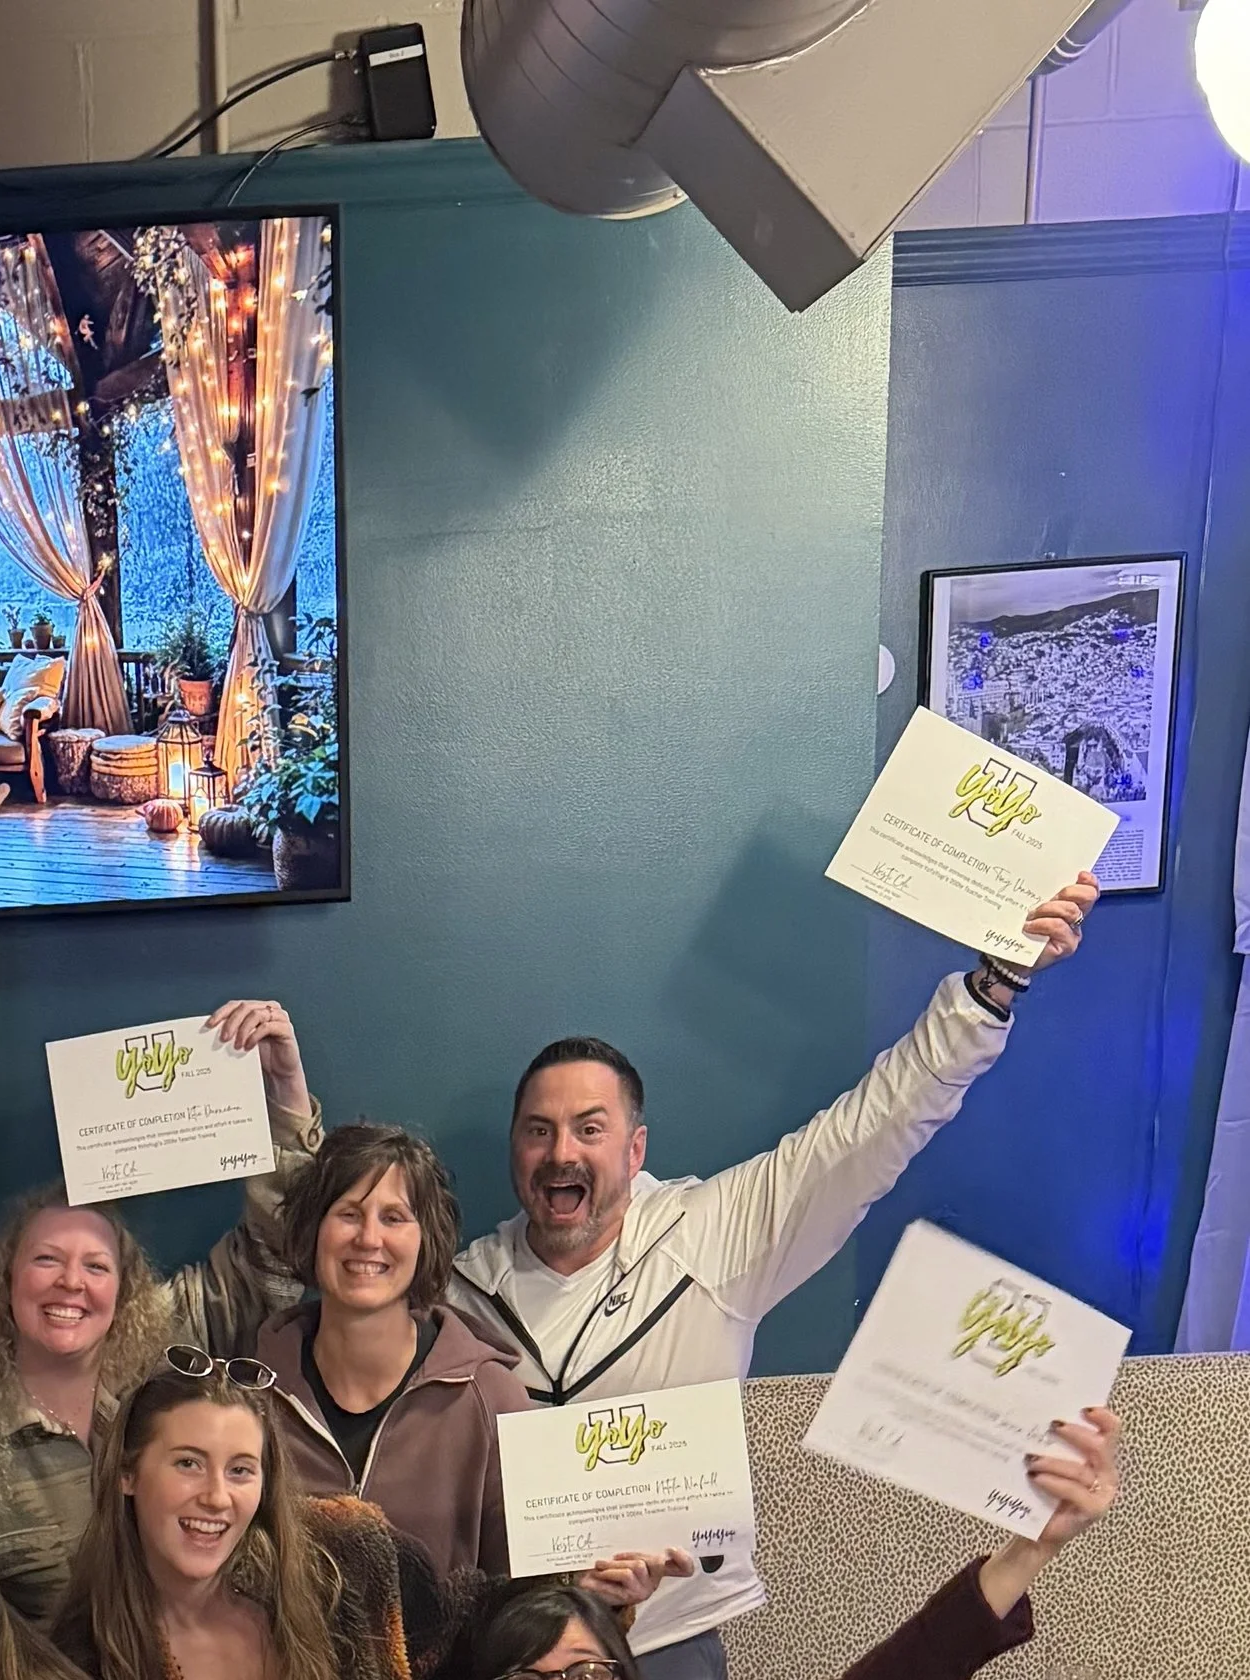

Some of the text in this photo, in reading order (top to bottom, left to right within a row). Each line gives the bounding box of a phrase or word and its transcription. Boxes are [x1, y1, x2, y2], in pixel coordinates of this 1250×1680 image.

[948, 764, 1042, 838] YoYo
[883, 813, 932, 843] CERTIFICATE
[930, 838, 944, 848] OF
[942, 843, 991, 874] COMPLETION
[1011, 829, 1043, 849] FALL 2025
[115, 1041, 194, 1098] YoYo
[181, 1070, 195, 1078] FALL
[79, 1122, 125, 1137] CERTIFICATE
[127, 1119, 136, 1128] OF
[139, 1112, 185, 1127] COMPLETION
[609, 1291, 628, 1306] NIKE
[575, 1412, 668, 1472] YoYo
[526, 1493, 580, 1508] CERTIFICATE
[582, 1492, 592, 1501] OF
[596, 1484, 650, 1499] COMPLETION
